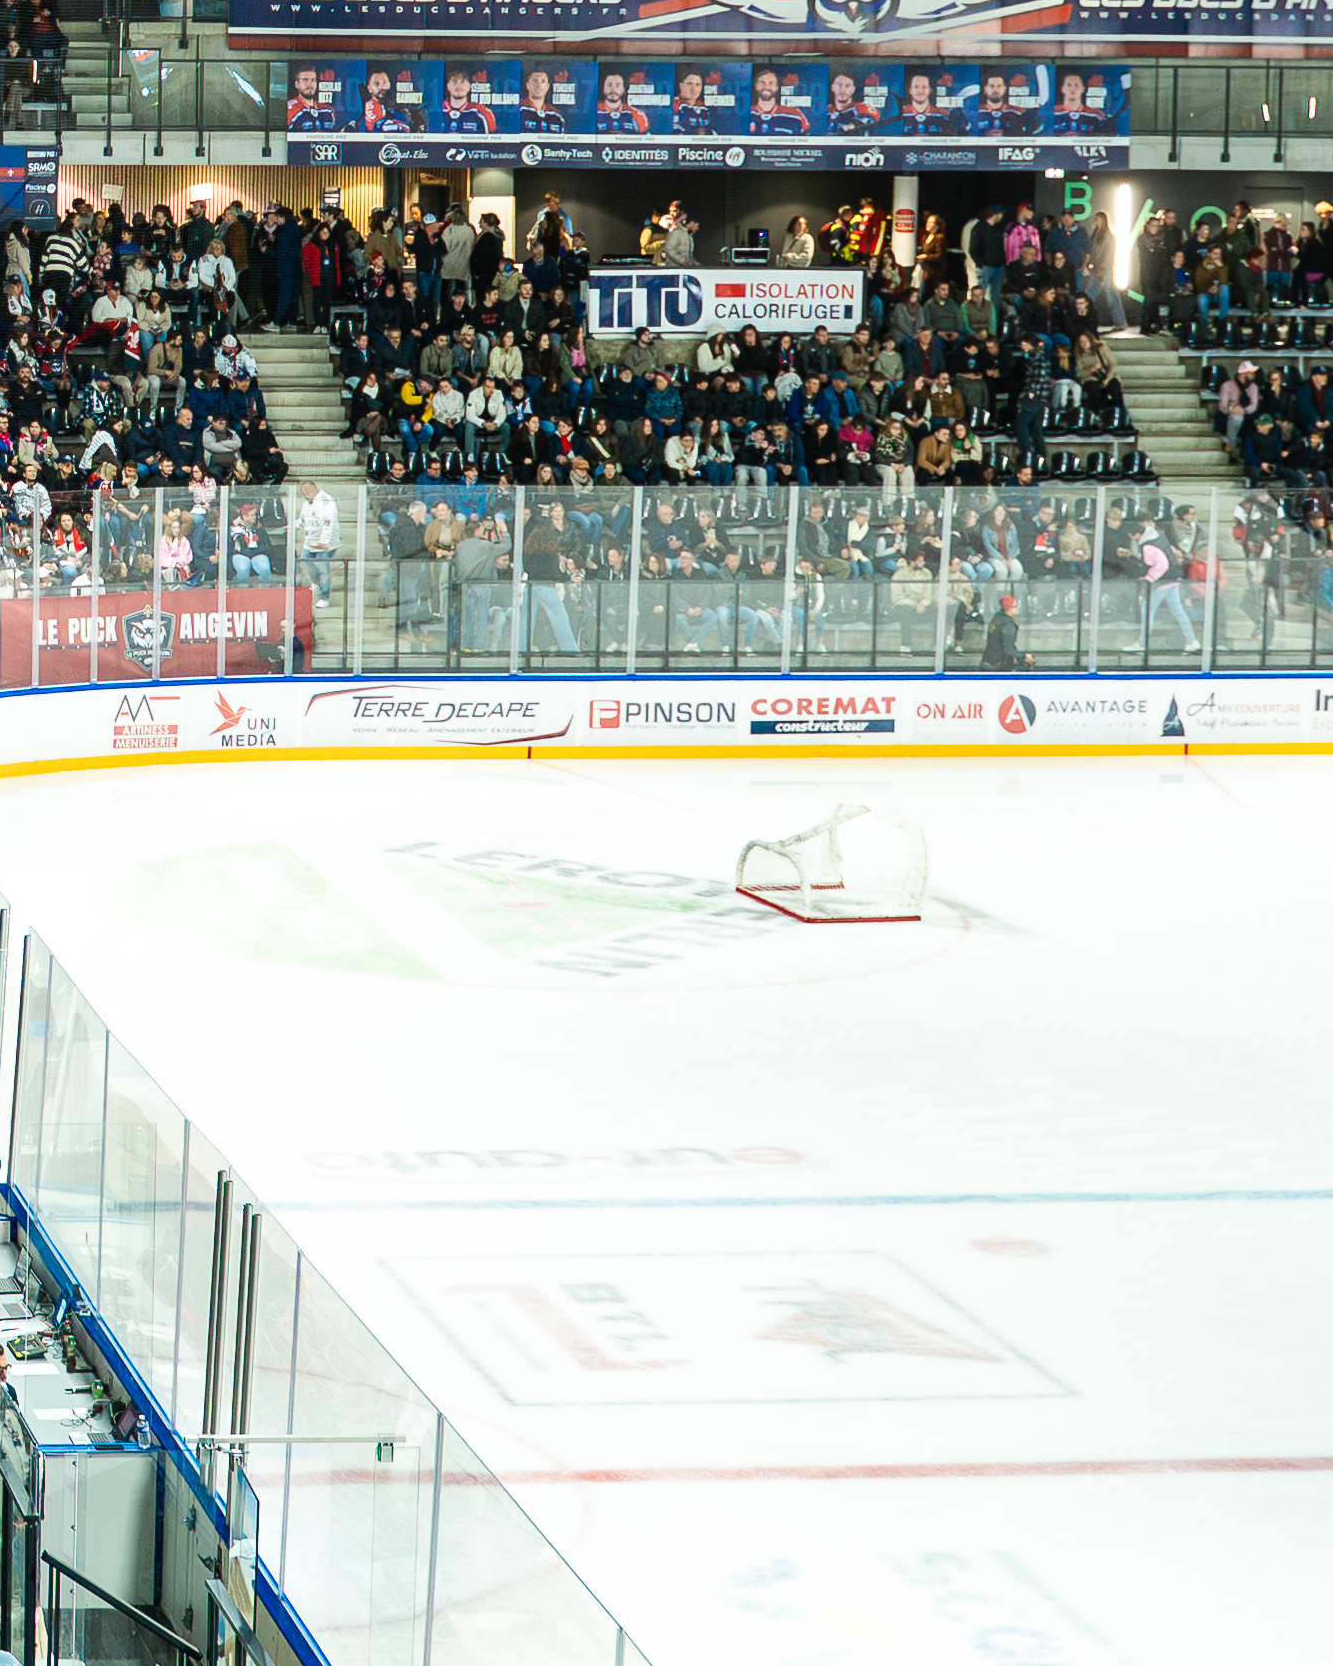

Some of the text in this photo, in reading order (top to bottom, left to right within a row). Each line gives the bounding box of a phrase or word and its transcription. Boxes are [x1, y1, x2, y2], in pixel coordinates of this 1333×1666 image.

[270, 4, 628, 15] WWW.LESDUCSDANGERS.FR
[678, 147, 724, 161] Piscine
[749, 283, 855, 300] ISOLATION
[715, 304, 841, 319] CALORIFUGE
[38, 611, 269, 646] LE PUCK ANGEVIN
[353, 695, 540, 722] TERRE DECAPE
[626, 702, 736, 723] PINSON
[750, 697, 895, 715] COREMAT
[916, 703, 983, 719] ON AIR
[1045, 700, 1148, 714] AVANTAGE
[122, 725, 171, 736] ARTINESS
[247, 718, 276, 730] UNI
[775, 720, 869, 733] constructeur
[115, 737, 177, 748] MENUISERIE
[222, 733, 276, 747] MEDIA
